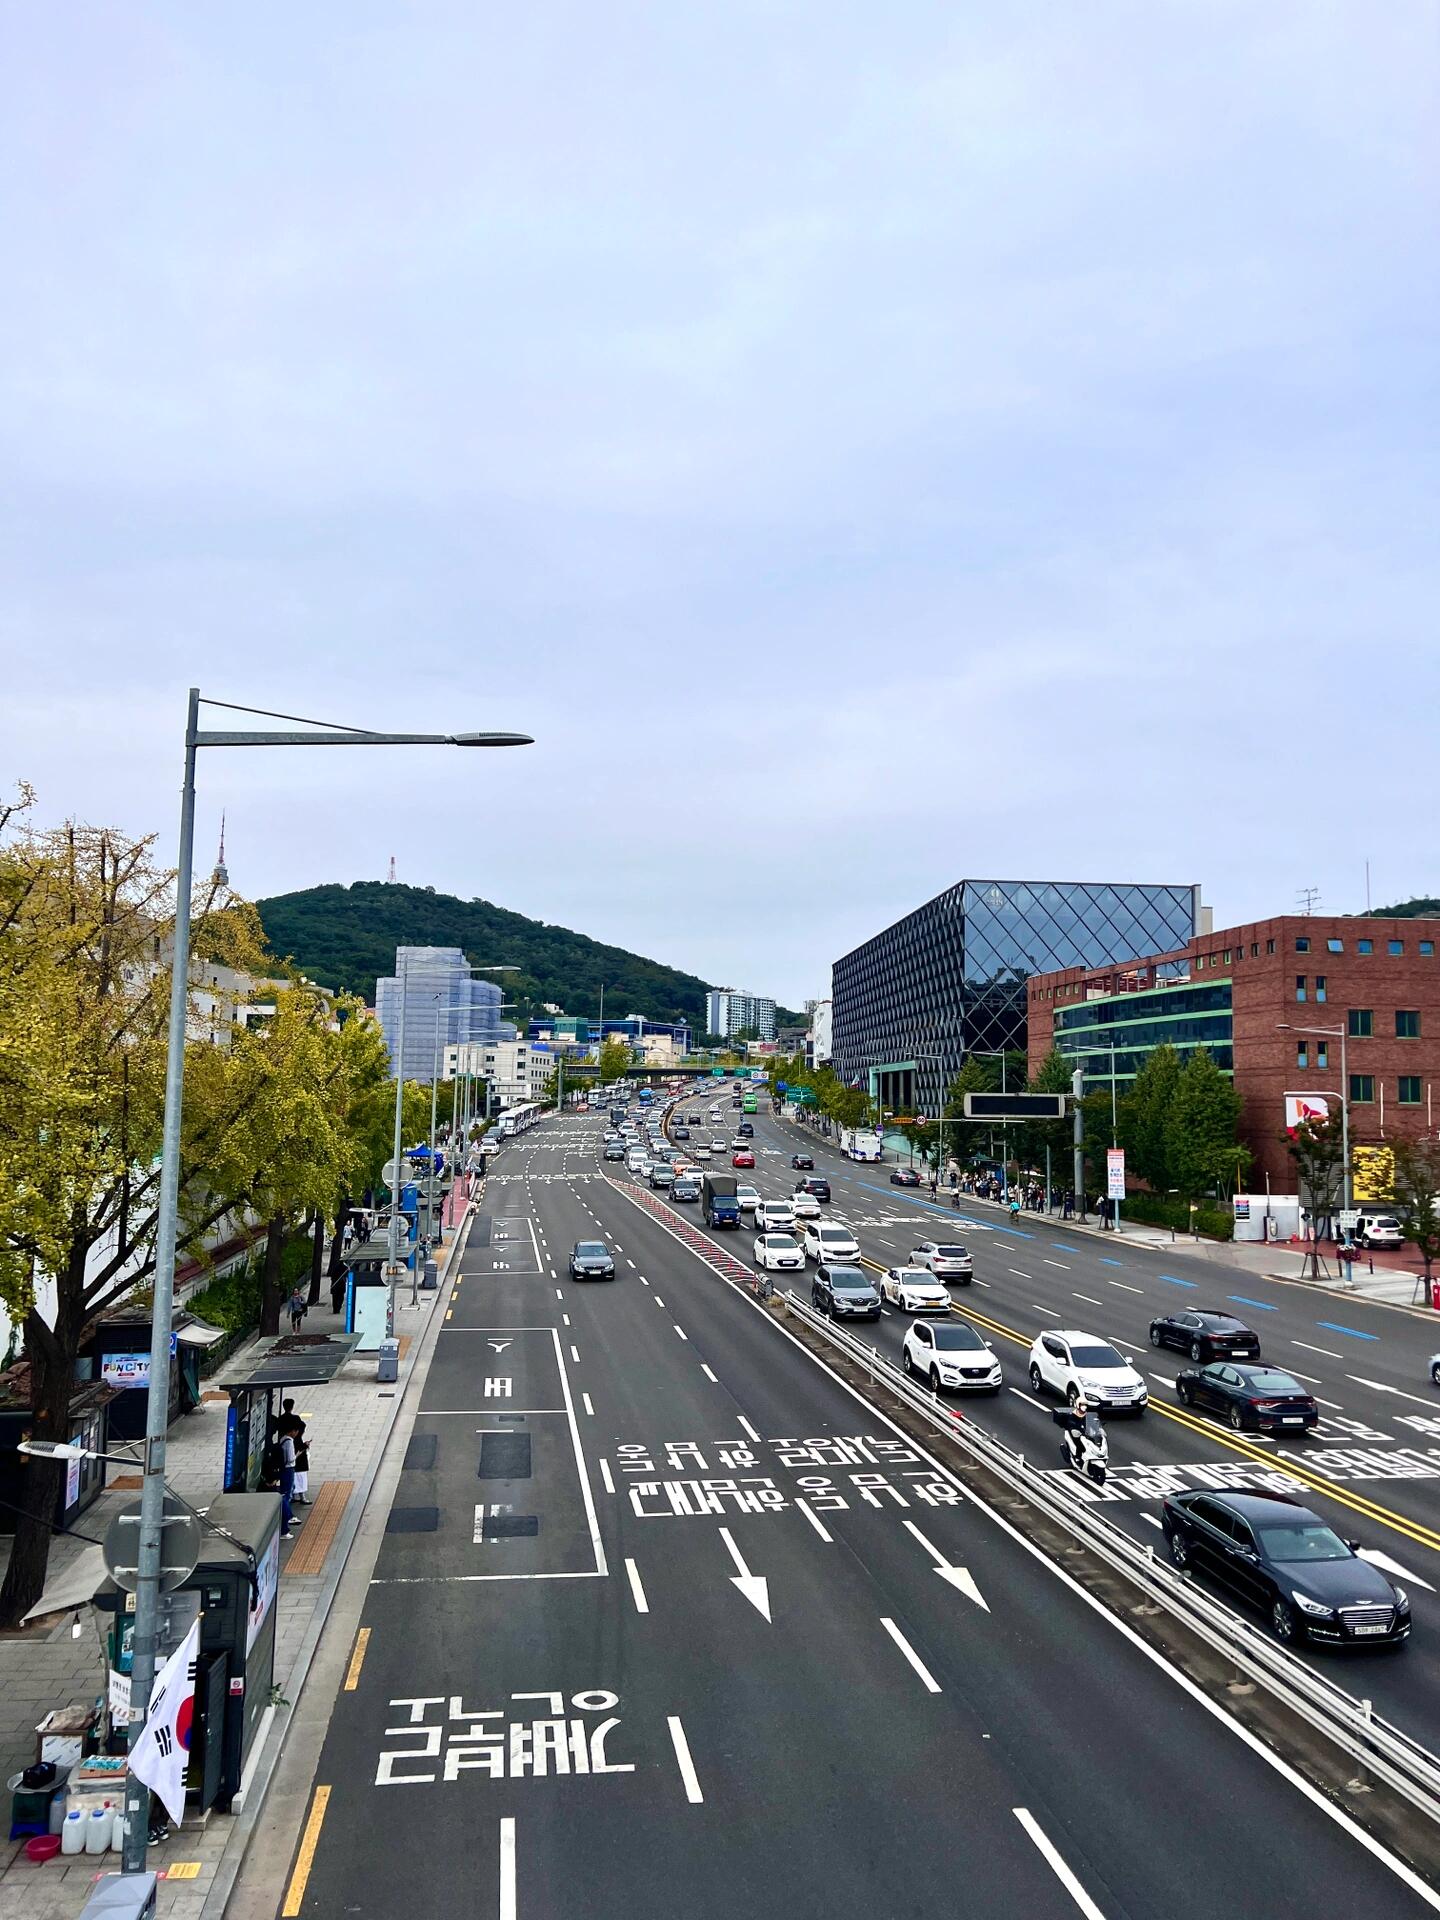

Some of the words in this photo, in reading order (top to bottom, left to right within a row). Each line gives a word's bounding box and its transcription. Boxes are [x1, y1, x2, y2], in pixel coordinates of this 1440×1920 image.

[768, 1435, 922, 1467] 독서당로
[629, 1478, 789, 1518] 한남대교
[375, 1690, 635, 1785] 강변북로
